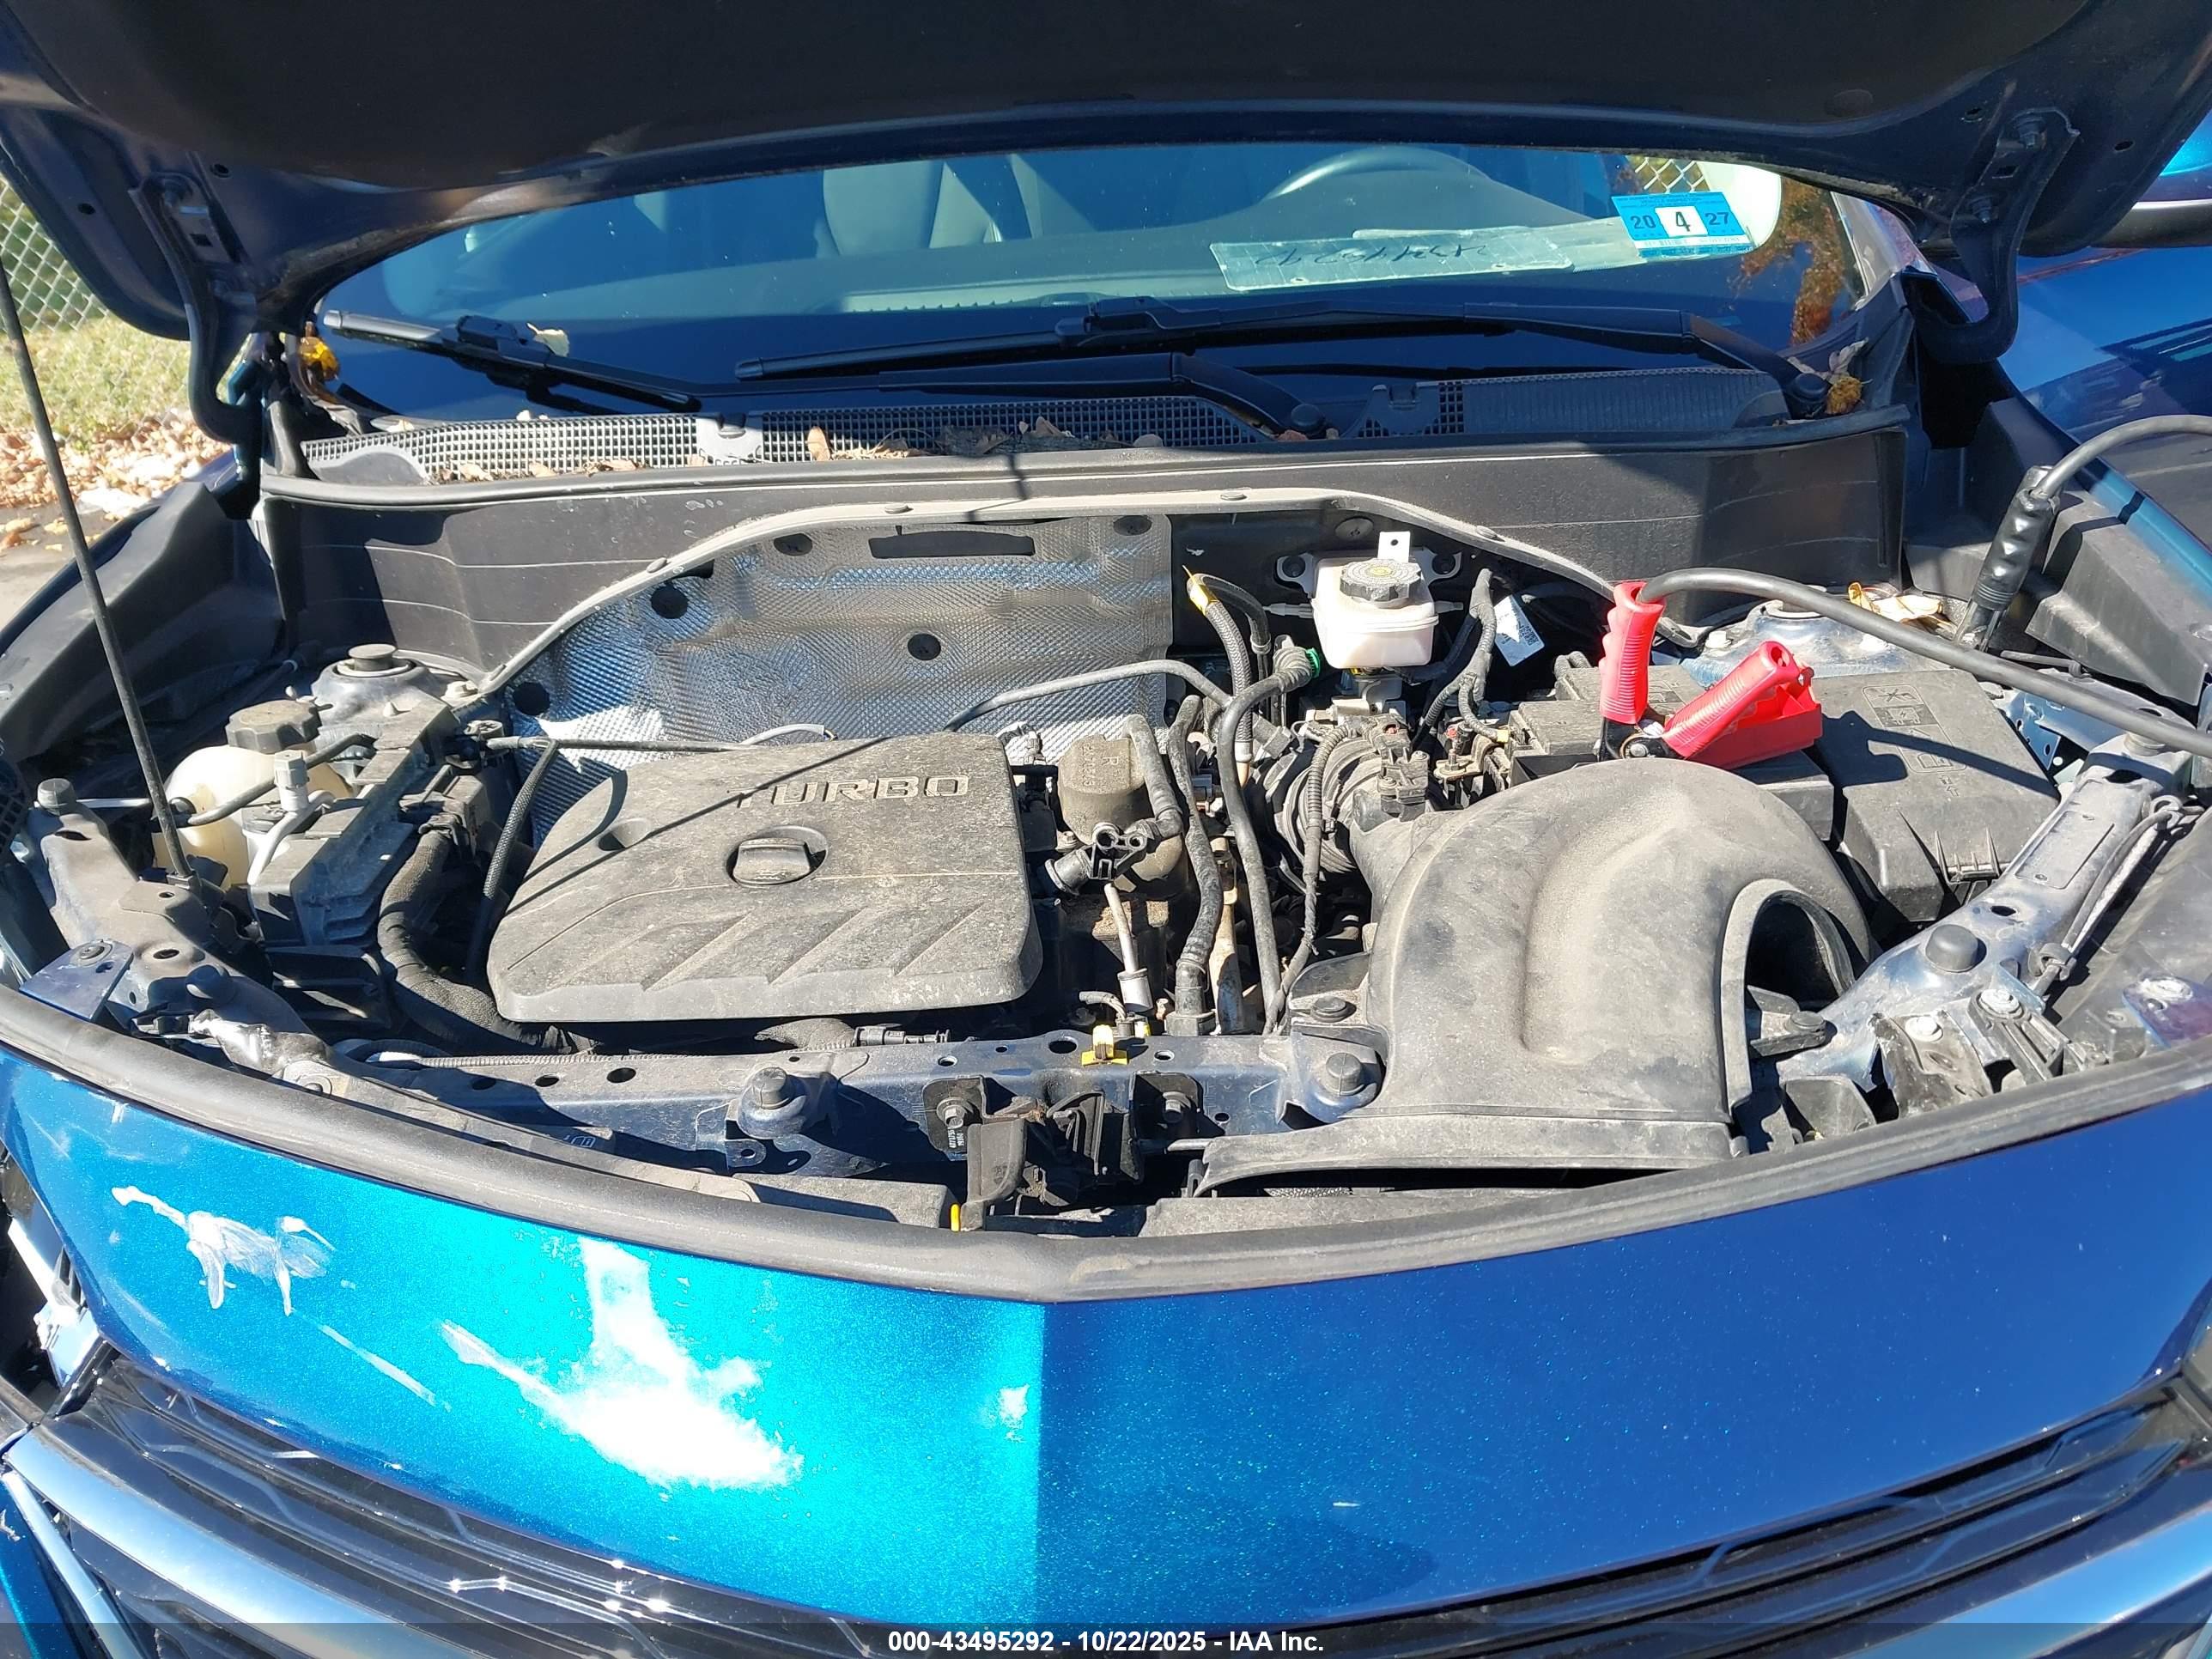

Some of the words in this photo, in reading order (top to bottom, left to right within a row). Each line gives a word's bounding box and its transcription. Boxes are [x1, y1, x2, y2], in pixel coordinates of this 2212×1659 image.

[1630, 215, 1656, 229] 20
[1674, 210, 1691, 233] 4
[1705, 211, 1729, 226] 27
[728, 775, 969, 808] TURBO
